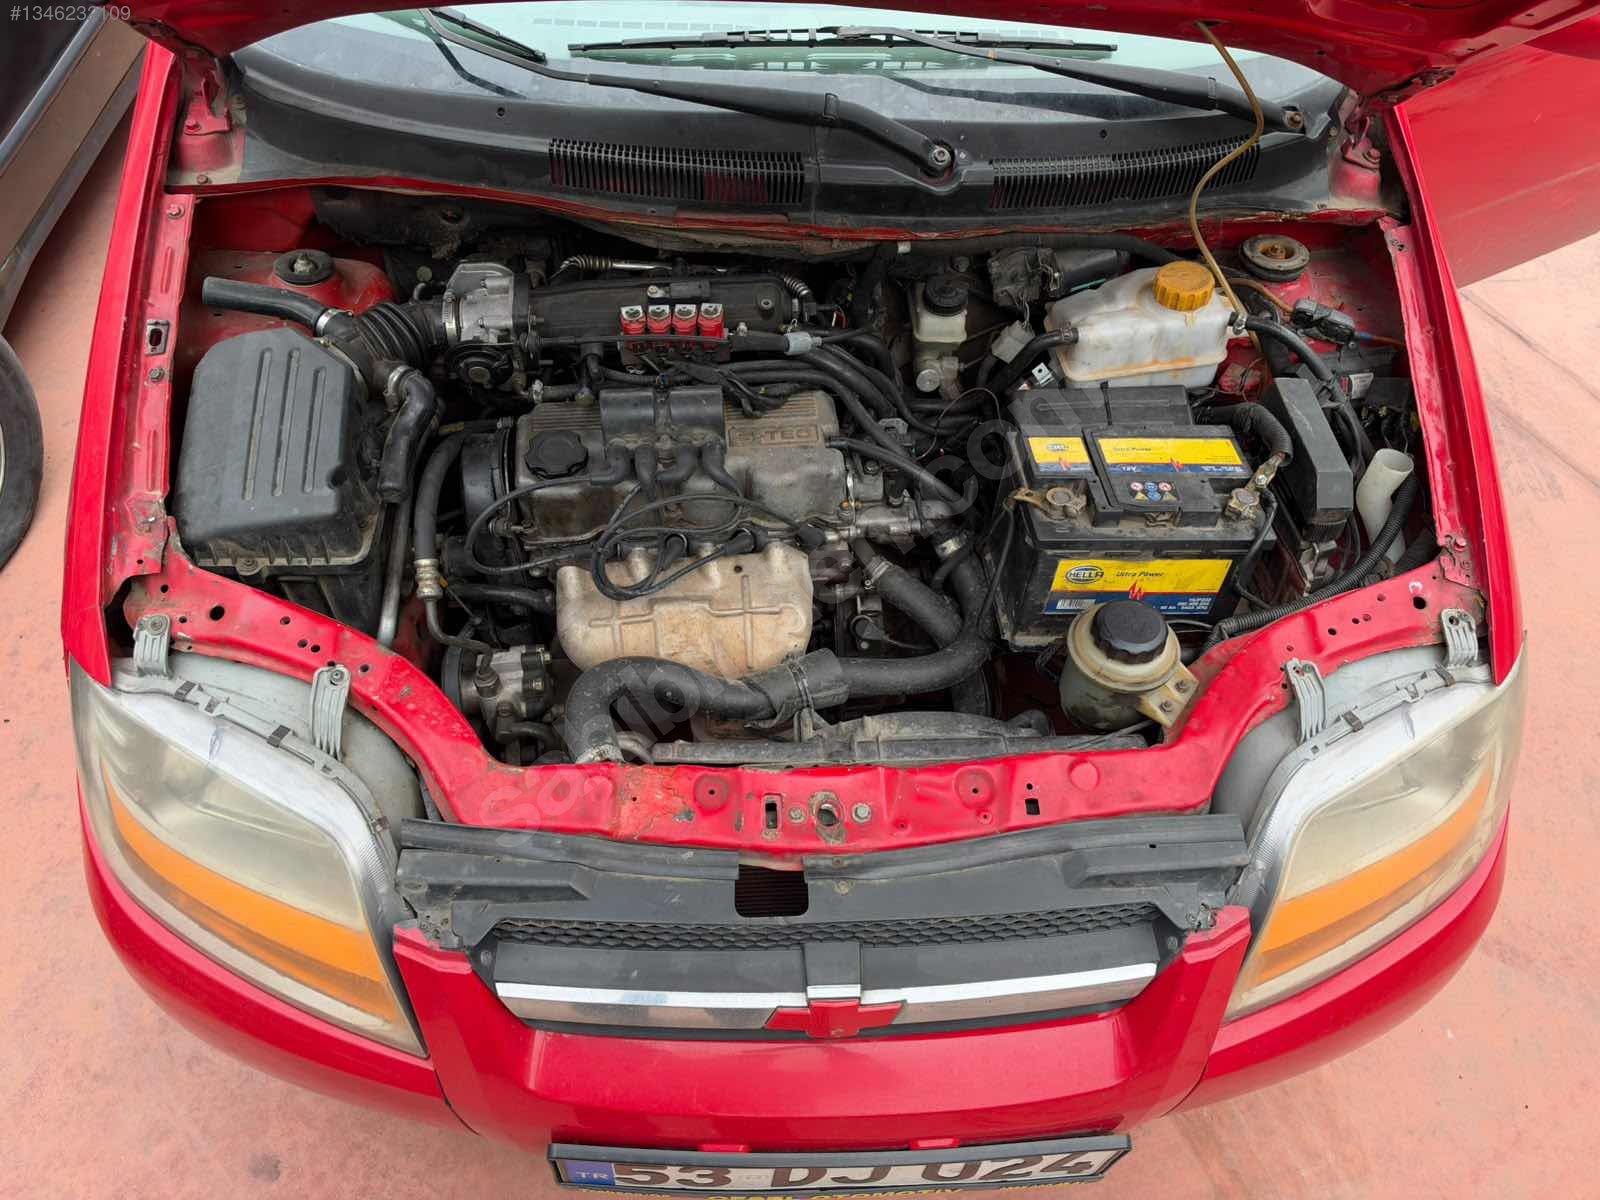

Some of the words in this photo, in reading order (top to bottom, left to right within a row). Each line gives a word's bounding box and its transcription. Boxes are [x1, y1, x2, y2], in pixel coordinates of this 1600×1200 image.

[1067, 569, 1105, 579] HELLA
[575, 1171, 609, 1180] TR
[616, 1165, 732, 1187] 53
[771, 1165, 892, 1188] DJ
